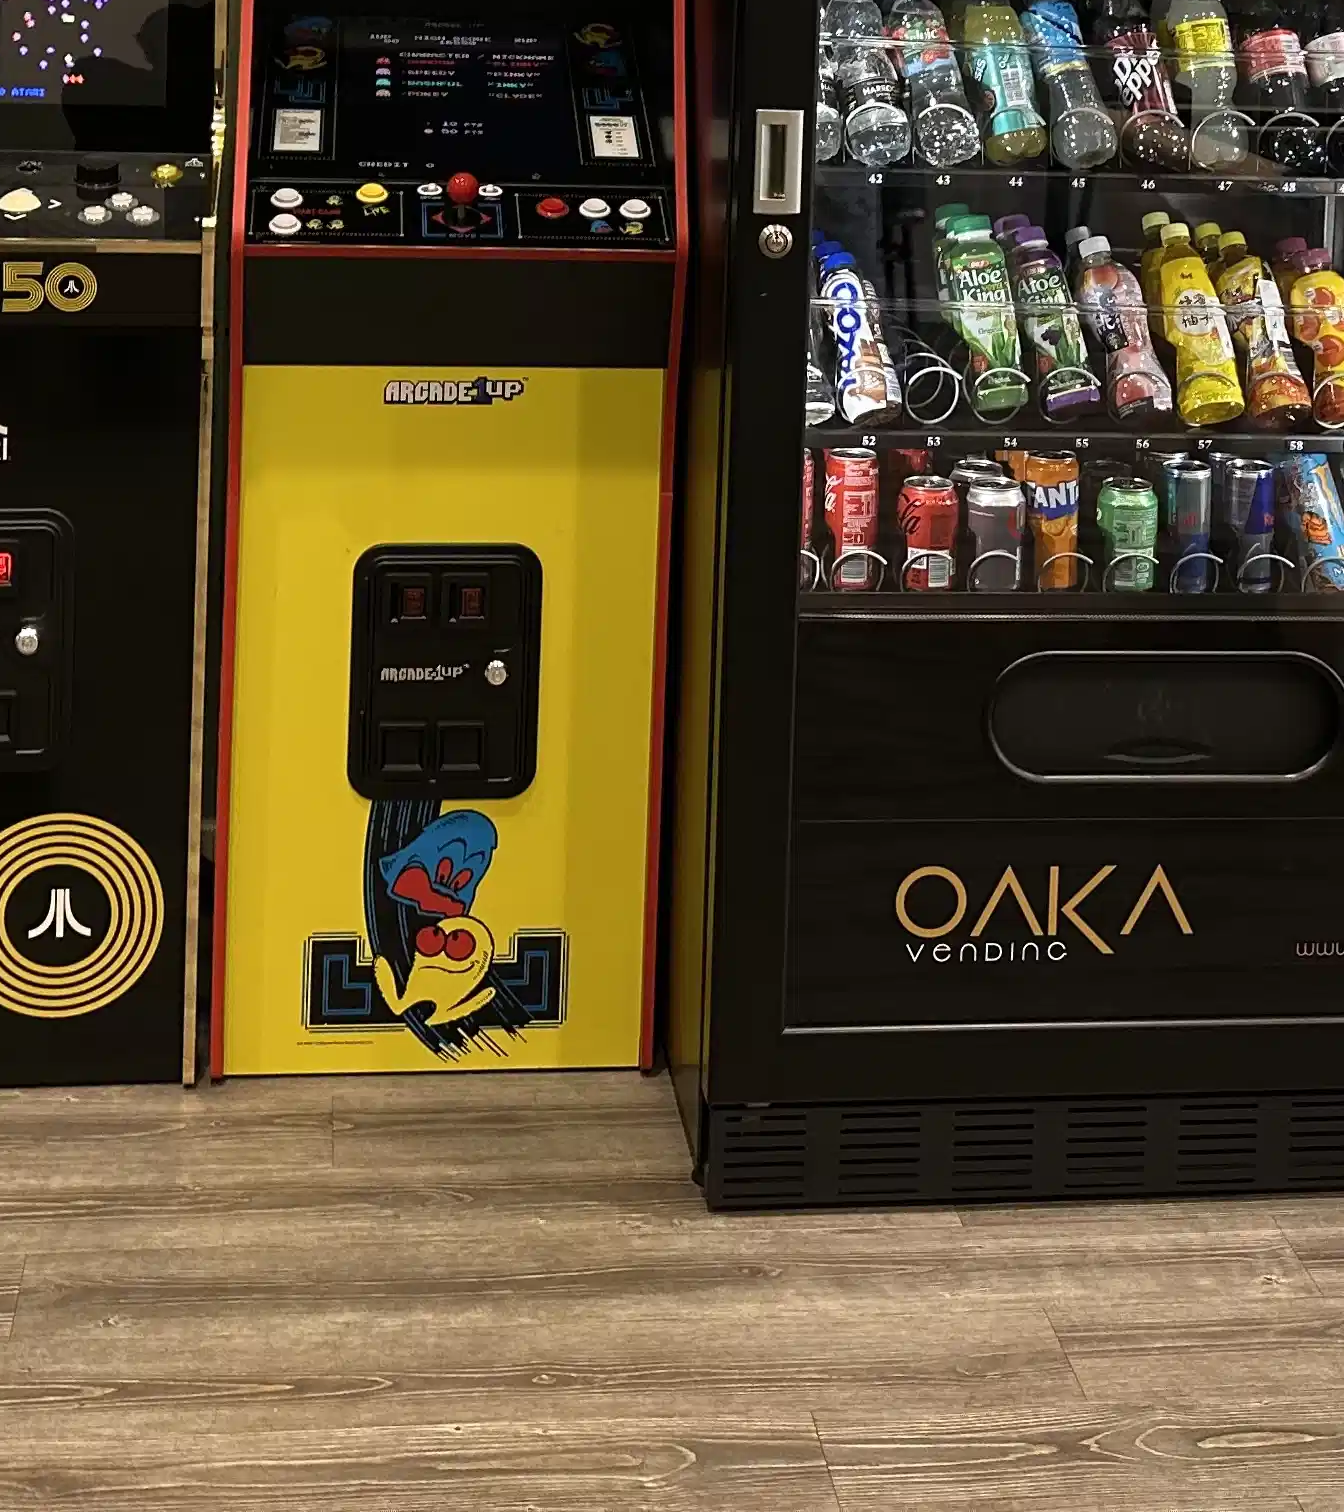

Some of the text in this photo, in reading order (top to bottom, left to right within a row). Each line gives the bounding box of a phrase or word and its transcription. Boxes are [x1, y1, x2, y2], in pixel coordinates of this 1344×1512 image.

[868, 174, 883, 184] 42
[936, 175, 951, 185] 43
[1009, 177, 1023, 188] 44
[1071, 178, 1086, 189] 45
[1141, 179, 1156, 190] 46
[1218, 180, 1233, 191] 47
[1282, 182, 1296, 193] 48
[960, 270, 1003, 288] Aloe
[1018, 275, 1061, 294] Aloe
[962, 288, 1006, 303] King
[862, 436, 876, 446] 52
[927, 437, 941, 447] 53
[1004, 437, 1018, 447] 54
[1075, 438, 1089, 448] 55
[1136, 439, 1150, 449] 56
[1198, 440, 1212, 450] 57
[1289, 441, 1304, 451] 58
[895, 862, 1195, 956] OAKA
